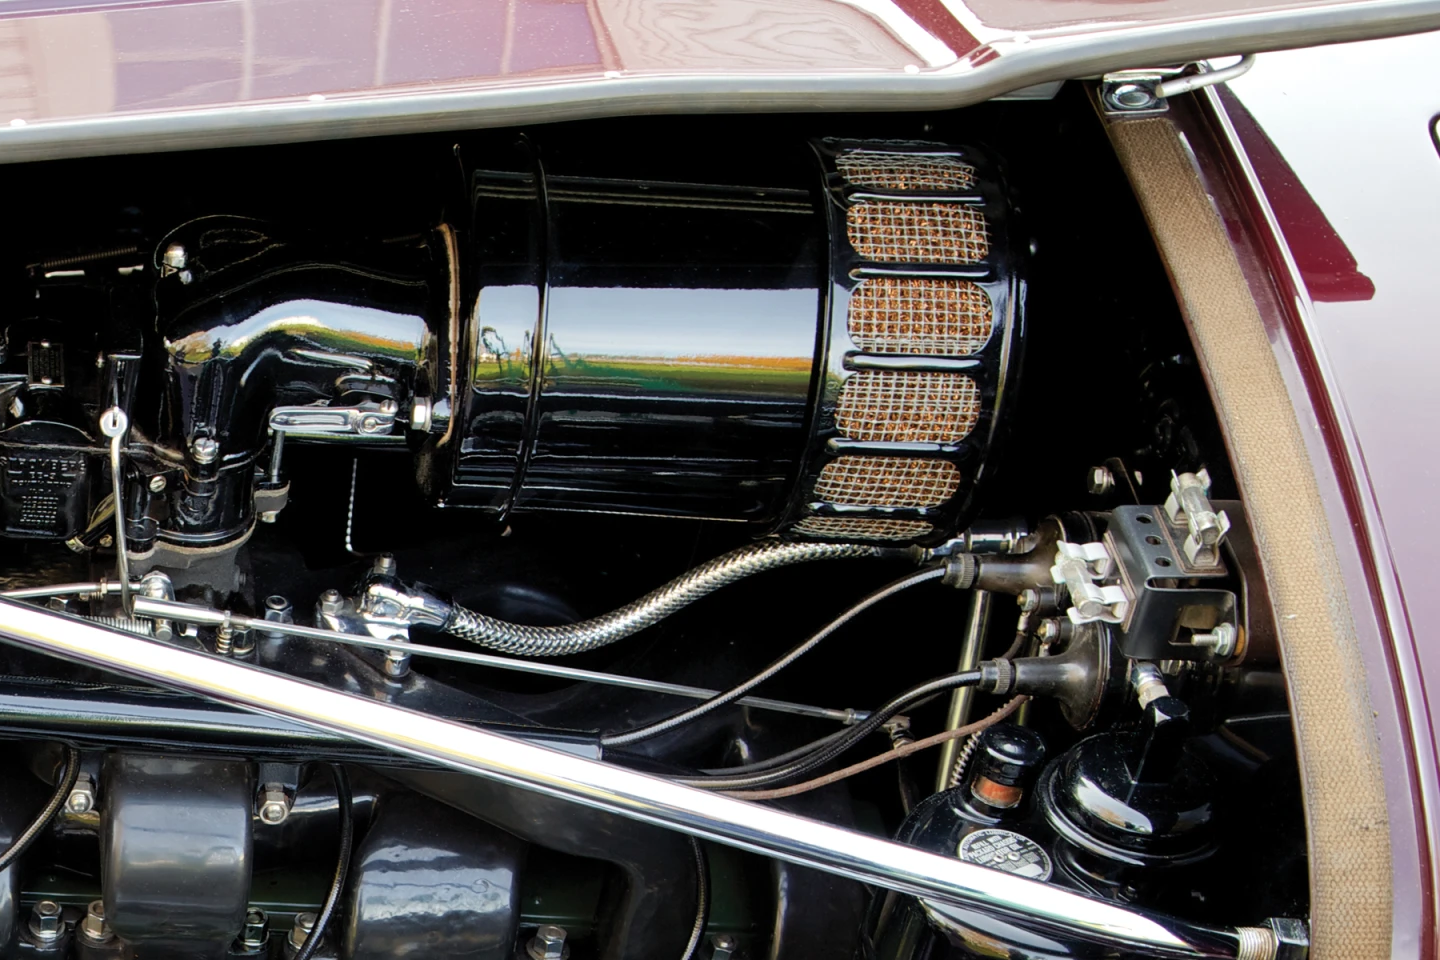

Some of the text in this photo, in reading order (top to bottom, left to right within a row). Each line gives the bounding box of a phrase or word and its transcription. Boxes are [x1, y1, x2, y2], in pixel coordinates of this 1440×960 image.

[0, 456, 85, 474] STROMBERG
[968, 845, 995, 858] PACKARD
[993, 836, 1017, 849] CHASSIS
[971, 840, 990, 850] REFILL
